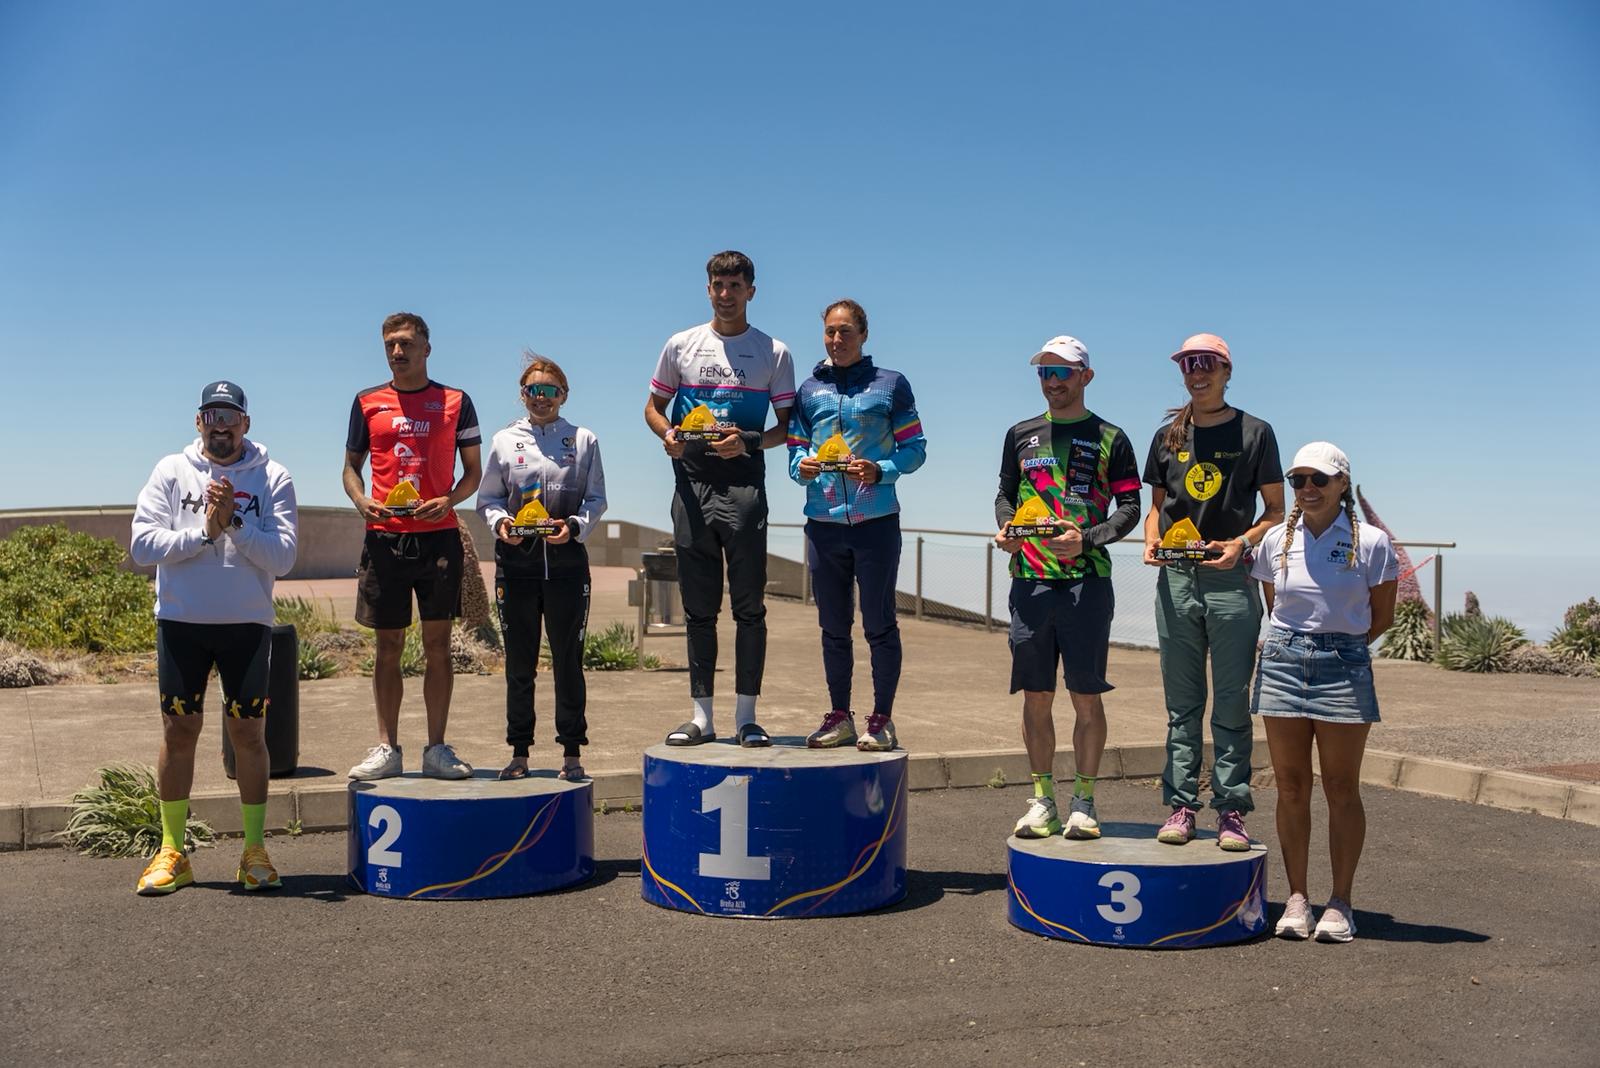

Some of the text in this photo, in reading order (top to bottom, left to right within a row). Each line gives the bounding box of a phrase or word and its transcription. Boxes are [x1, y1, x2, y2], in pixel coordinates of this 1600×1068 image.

[699, 363, 746, 379] PEÑOTA
[1036, 516, 1055, 525] KOS
[1186, 540, 1206, 549] KOS
[367, 804, 402, 868] 2
[699, 775, 771, 880] 1
[1096, 870, 1143, 924] 3
